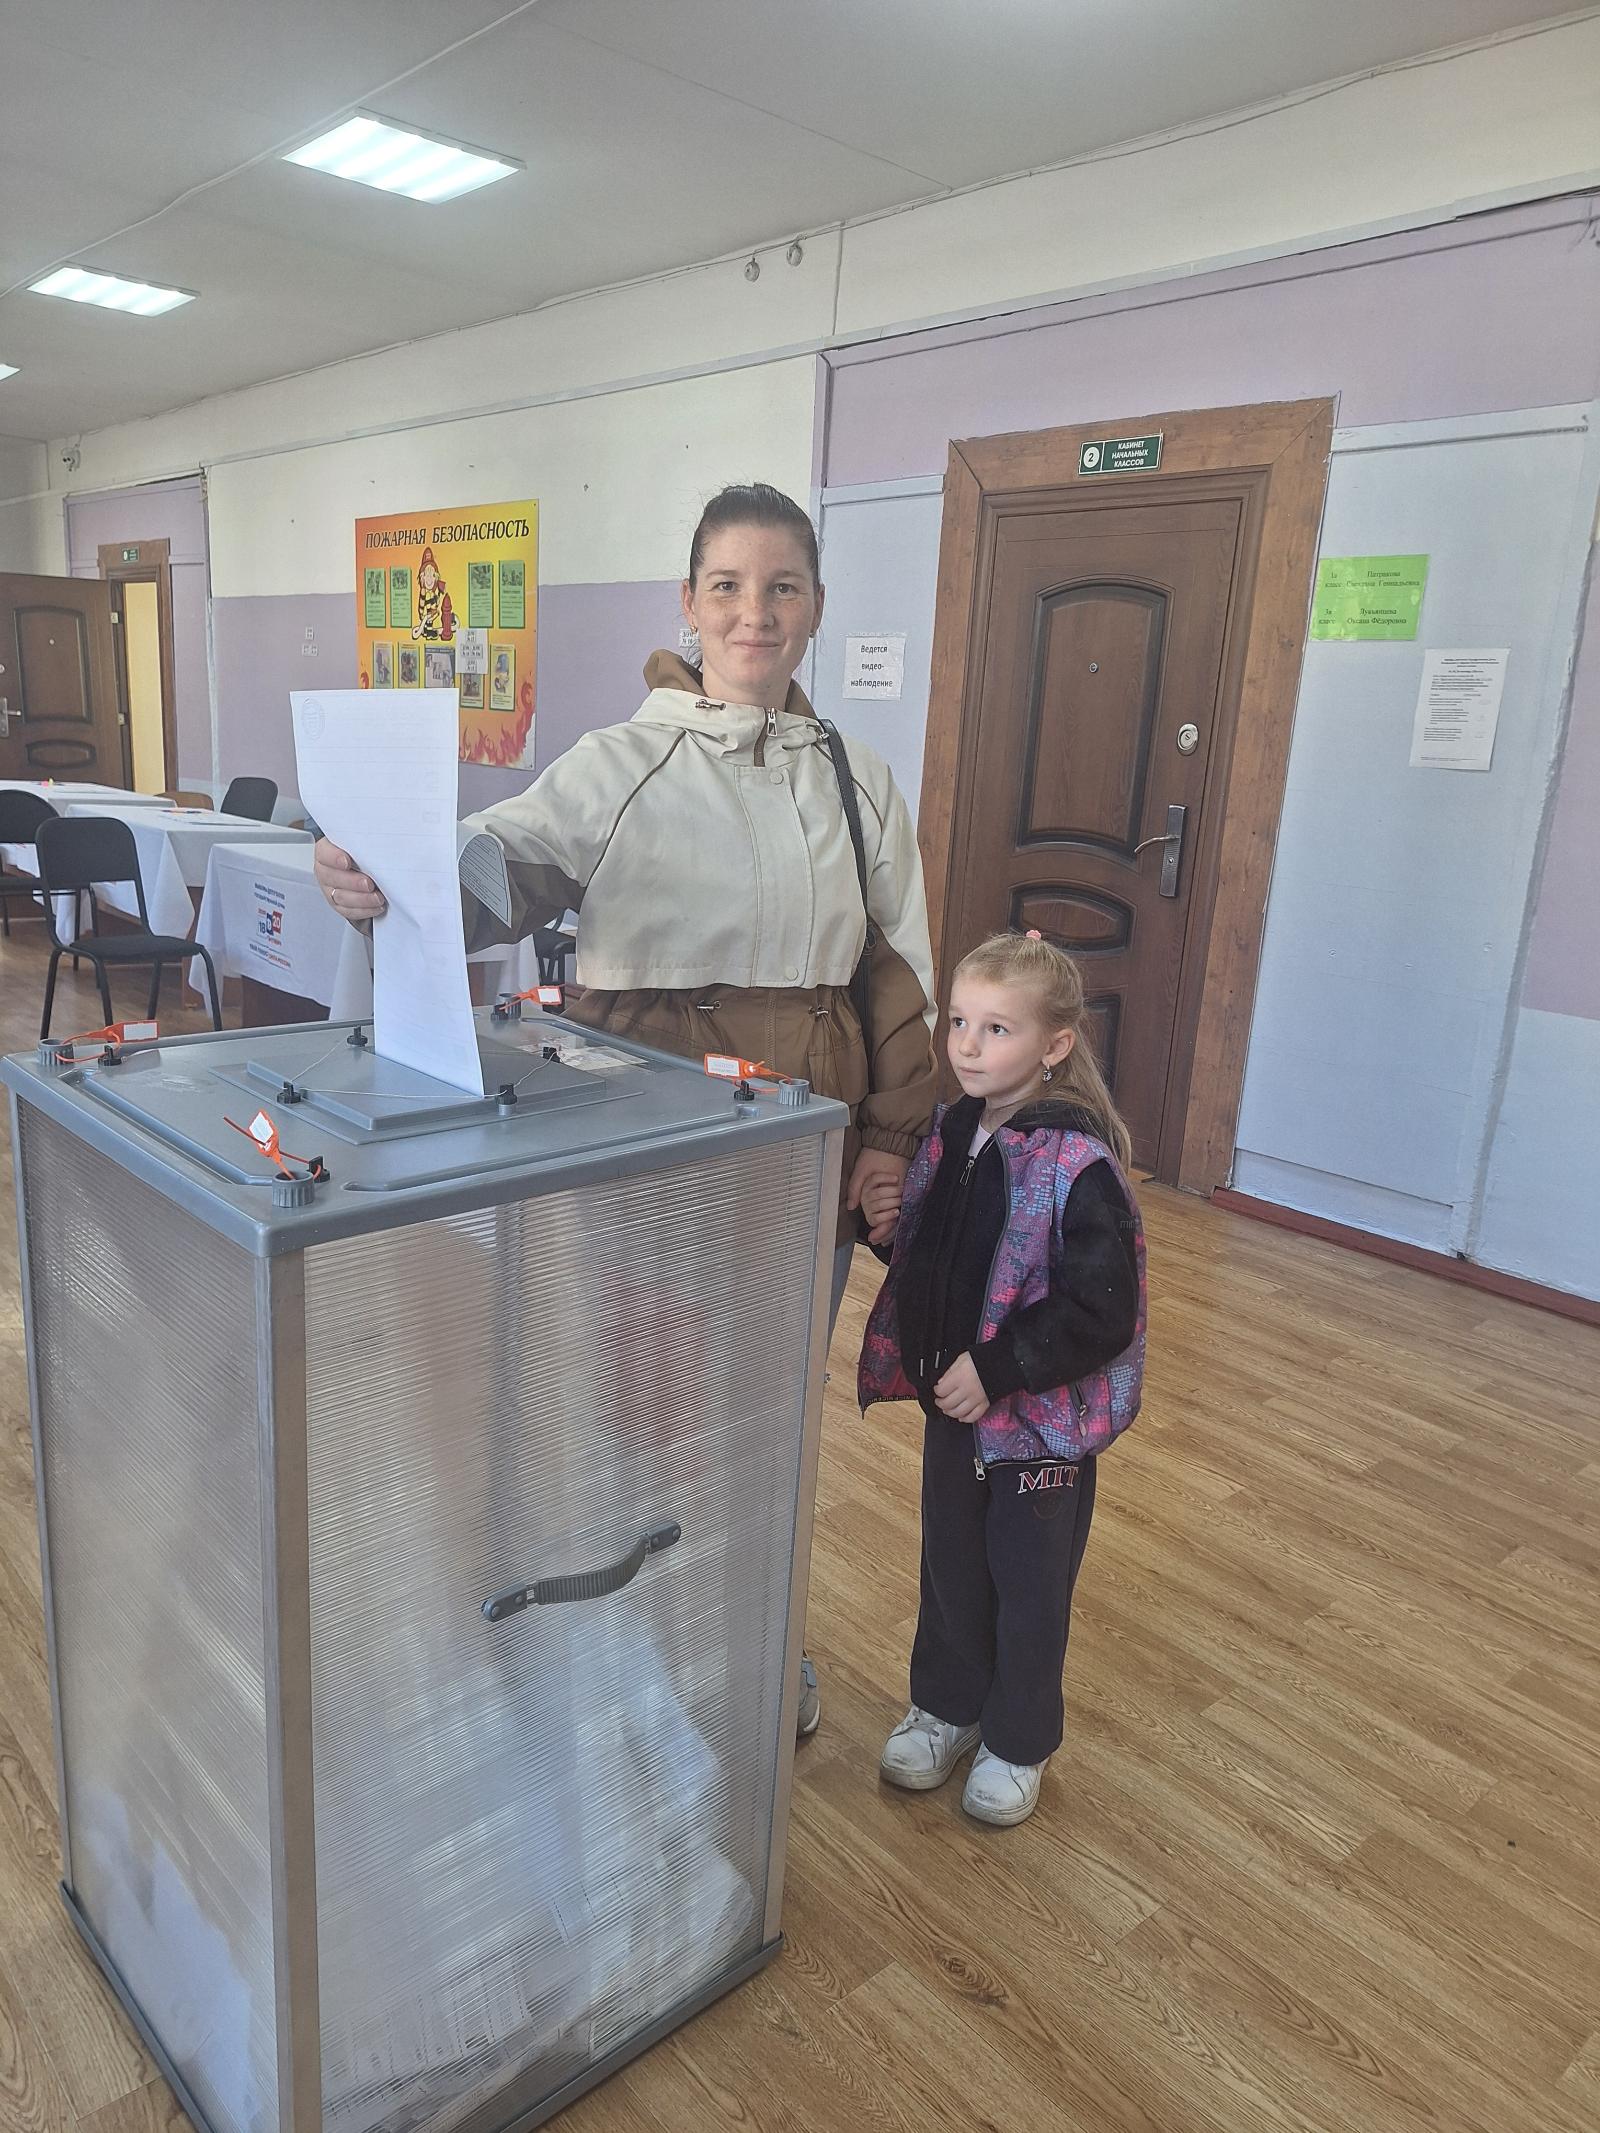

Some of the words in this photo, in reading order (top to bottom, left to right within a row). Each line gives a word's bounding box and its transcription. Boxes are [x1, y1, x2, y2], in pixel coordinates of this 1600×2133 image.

[1118, 441, 1145, 450] КАБИНЕТ
[1088, 453, 1094, 462] 2
[1111, 449, 1149, 459] НАЧАЛЬНЫХ
[1114, 458, 1144, 468] КЛАССОВ
[366, 528, 426, 548] ПОЖАРНАЯ
[432, 519, 529, 544] БЕЗОПАСНОСТЬ
[861, 645, 888, 654] Ведется
[861, 663, 884, 671] видео-
[850, 678, 893, 688] наблюдение
[1018, 1466, 1079, 1494] MIT
